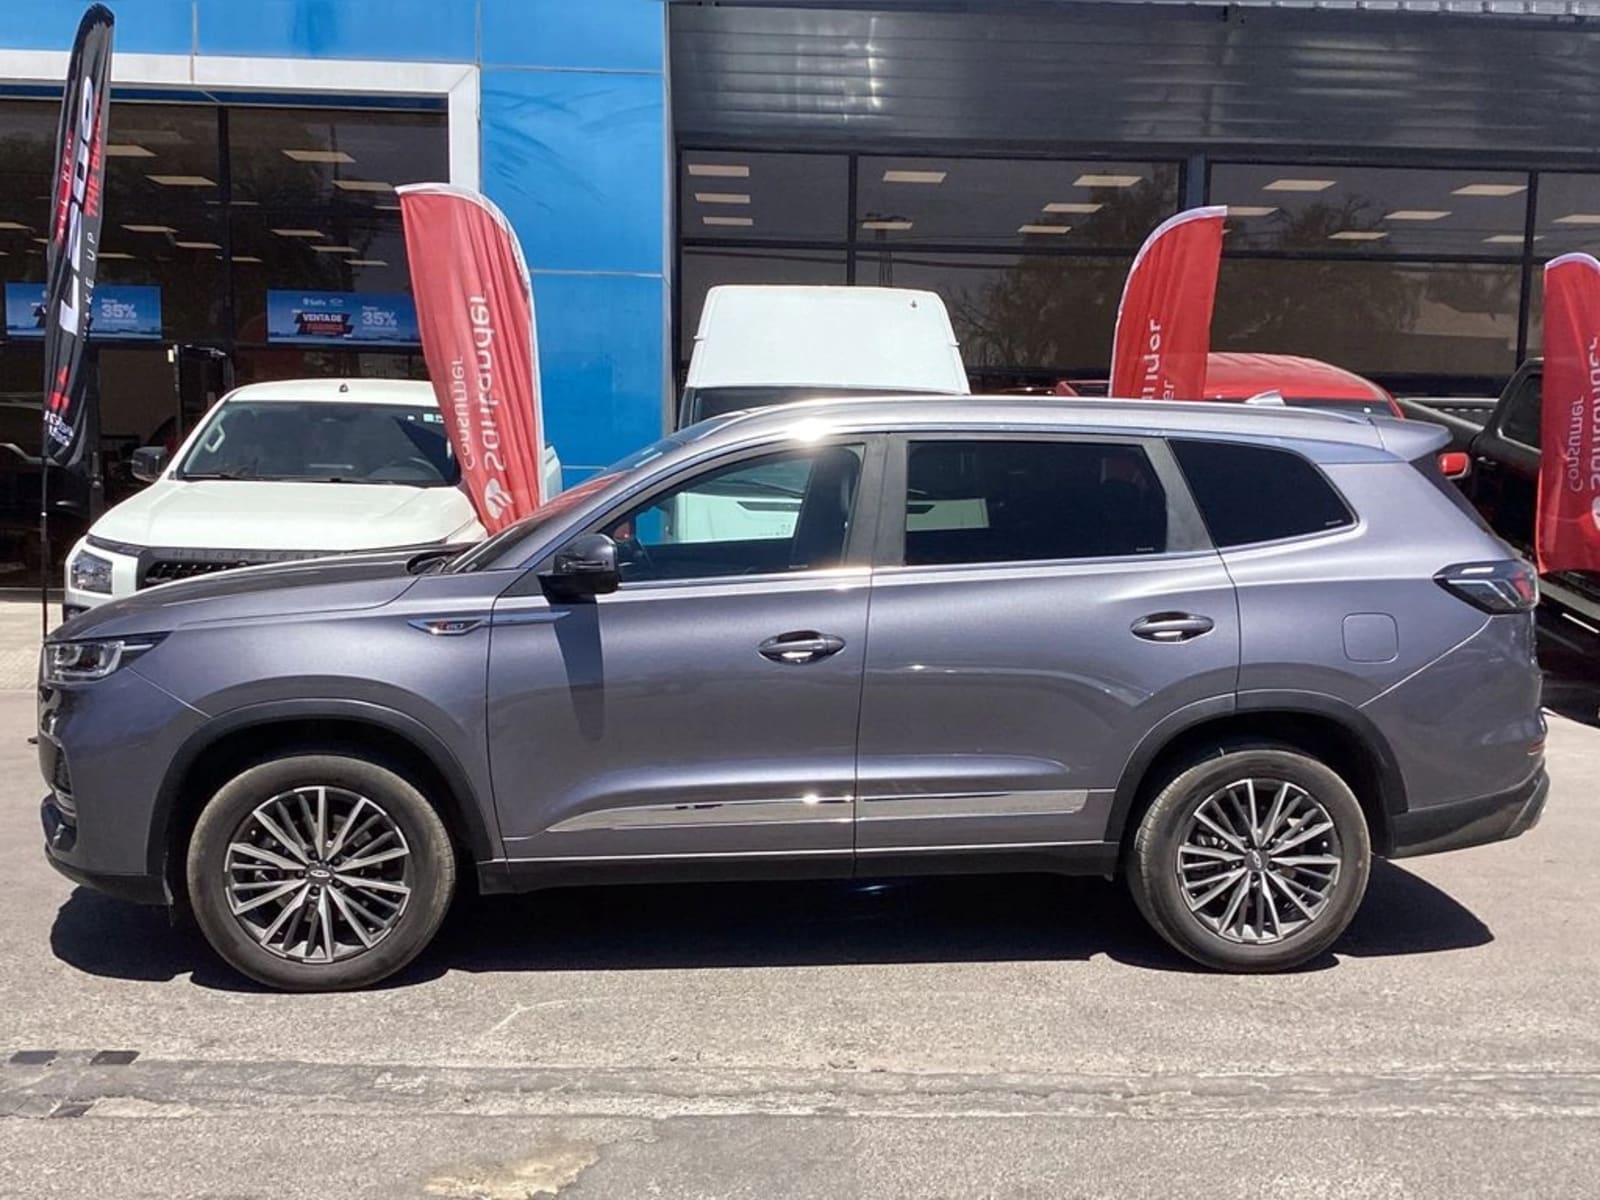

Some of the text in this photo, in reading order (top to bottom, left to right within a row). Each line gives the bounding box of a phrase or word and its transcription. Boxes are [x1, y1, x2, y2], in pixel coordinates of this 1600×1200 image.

[83, 175, 100, 217] THE
[87, 231, 96, 261] UP
[101, 303, 137, 319] 35%
[362, 311, 397, 326] 35%
